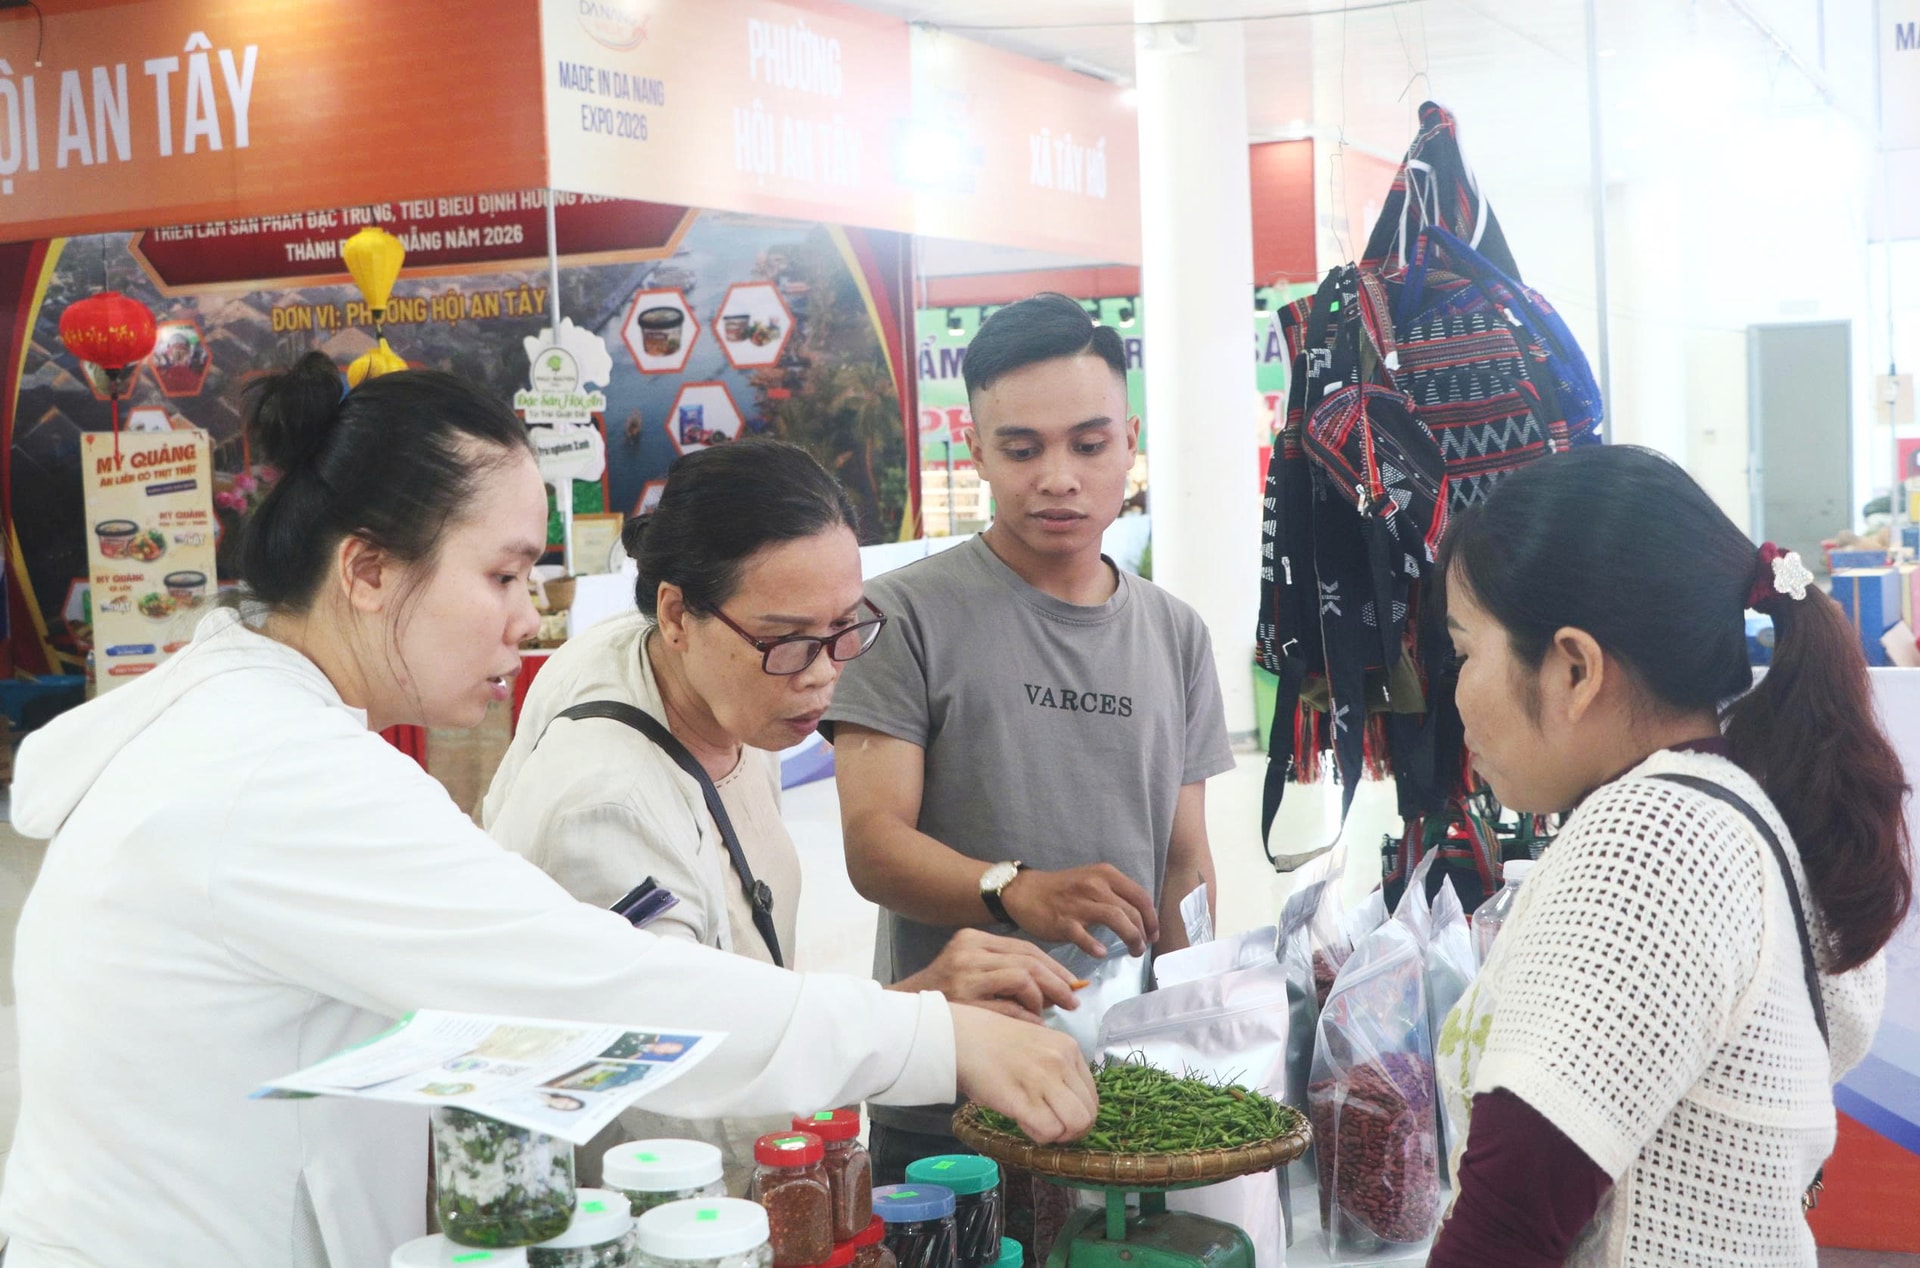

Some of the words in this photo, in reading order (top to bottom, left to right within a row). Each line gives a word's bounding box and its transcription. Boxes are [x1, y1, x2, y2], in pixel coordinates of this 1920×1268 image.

[57, 63, 132, 169] AN
[144, 31, 259, 157] TÂY
[559, 60, 596, 95] MADE
[598, 68, 611, 97] IN
[613, 71, 631, 101] DA
[632, 75, 665, 107] NANG
[581, 103, 614, 135] EXPO
[616, 110, 648, 141] 2026
[734, 97, 776, 187] HỘI
[479, 191, 517, 218] ĐỊNH
[285, 237, 337, 262] THÀNH
[446, 226, 481, 249] NĂM
[484, 224, 524, 246] 2026
[271, 304, 313, 332] ĐƠN
[315, 303, 341, 335] VỊ:
[431, 289, 466, 326] HỘI
[470, 293, 500, 319] AN
[503, 284, 548, 317] TÂY
[130, 443, 196, 469] QUẢNG
[1023, 683, 1133, 718] VARCES
